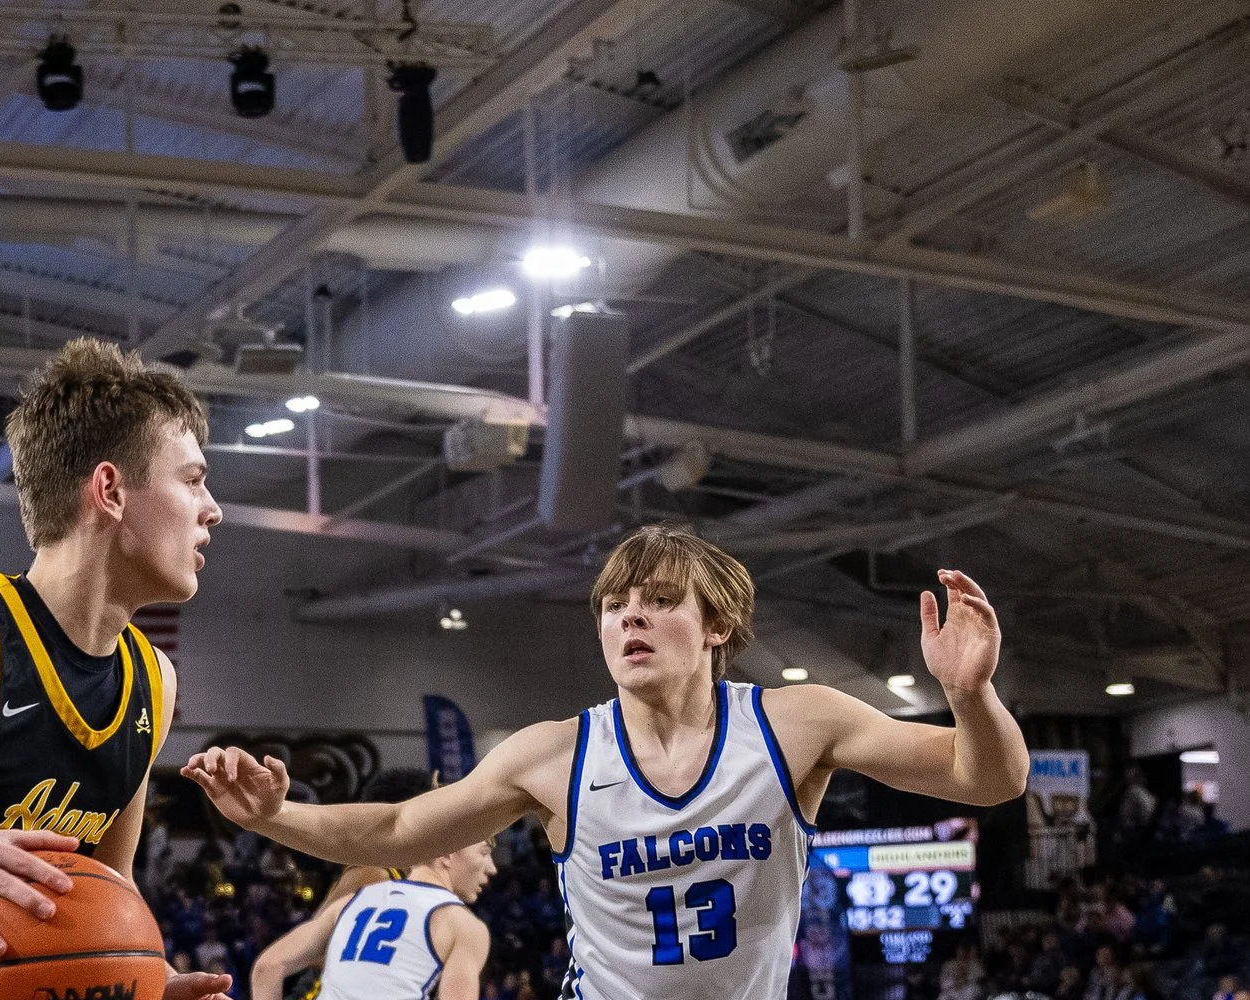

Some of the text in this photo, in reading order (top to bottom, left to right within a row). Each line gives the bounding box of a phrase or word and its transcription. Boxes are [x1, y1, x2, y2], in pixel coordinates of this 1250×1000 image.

[597, 822, 773, 881] FALCONS
[903, 870, 958, 907] 29
[339, 906, 410, 967] 12
[644, 877, 738, 966] 13
